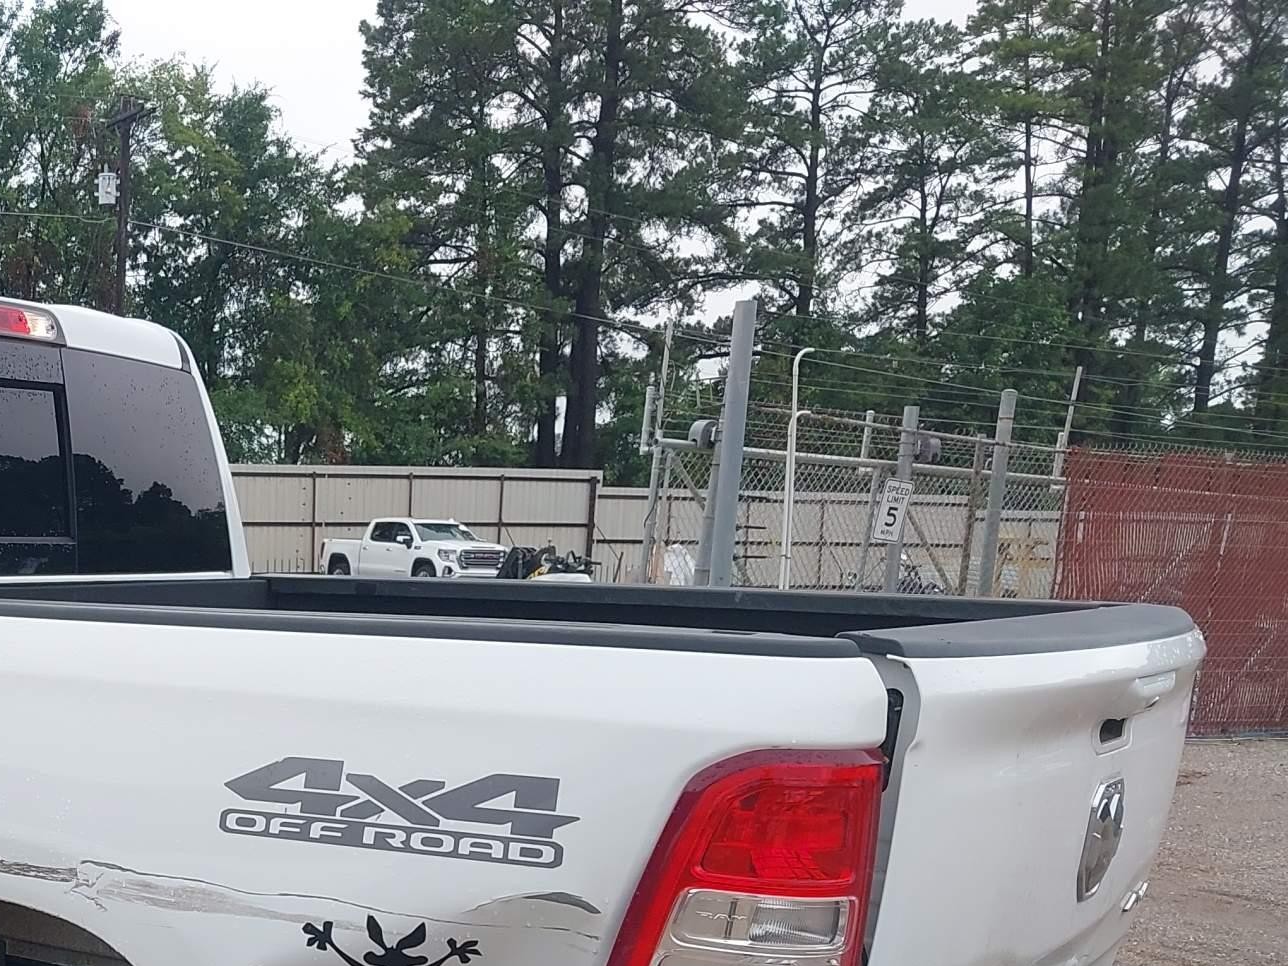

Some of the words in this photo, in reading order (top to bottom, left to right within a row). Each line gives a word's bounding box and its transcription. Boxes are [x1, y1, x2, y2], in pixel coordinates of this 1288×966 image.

[886, 485, 910, 497] SPEED
[886, 495, 906, 505] LIMIT
[884, 506, 899, 527] 5
[224, 810, 349, 840] OFF
[362, 826, 555, 864] ROAD
